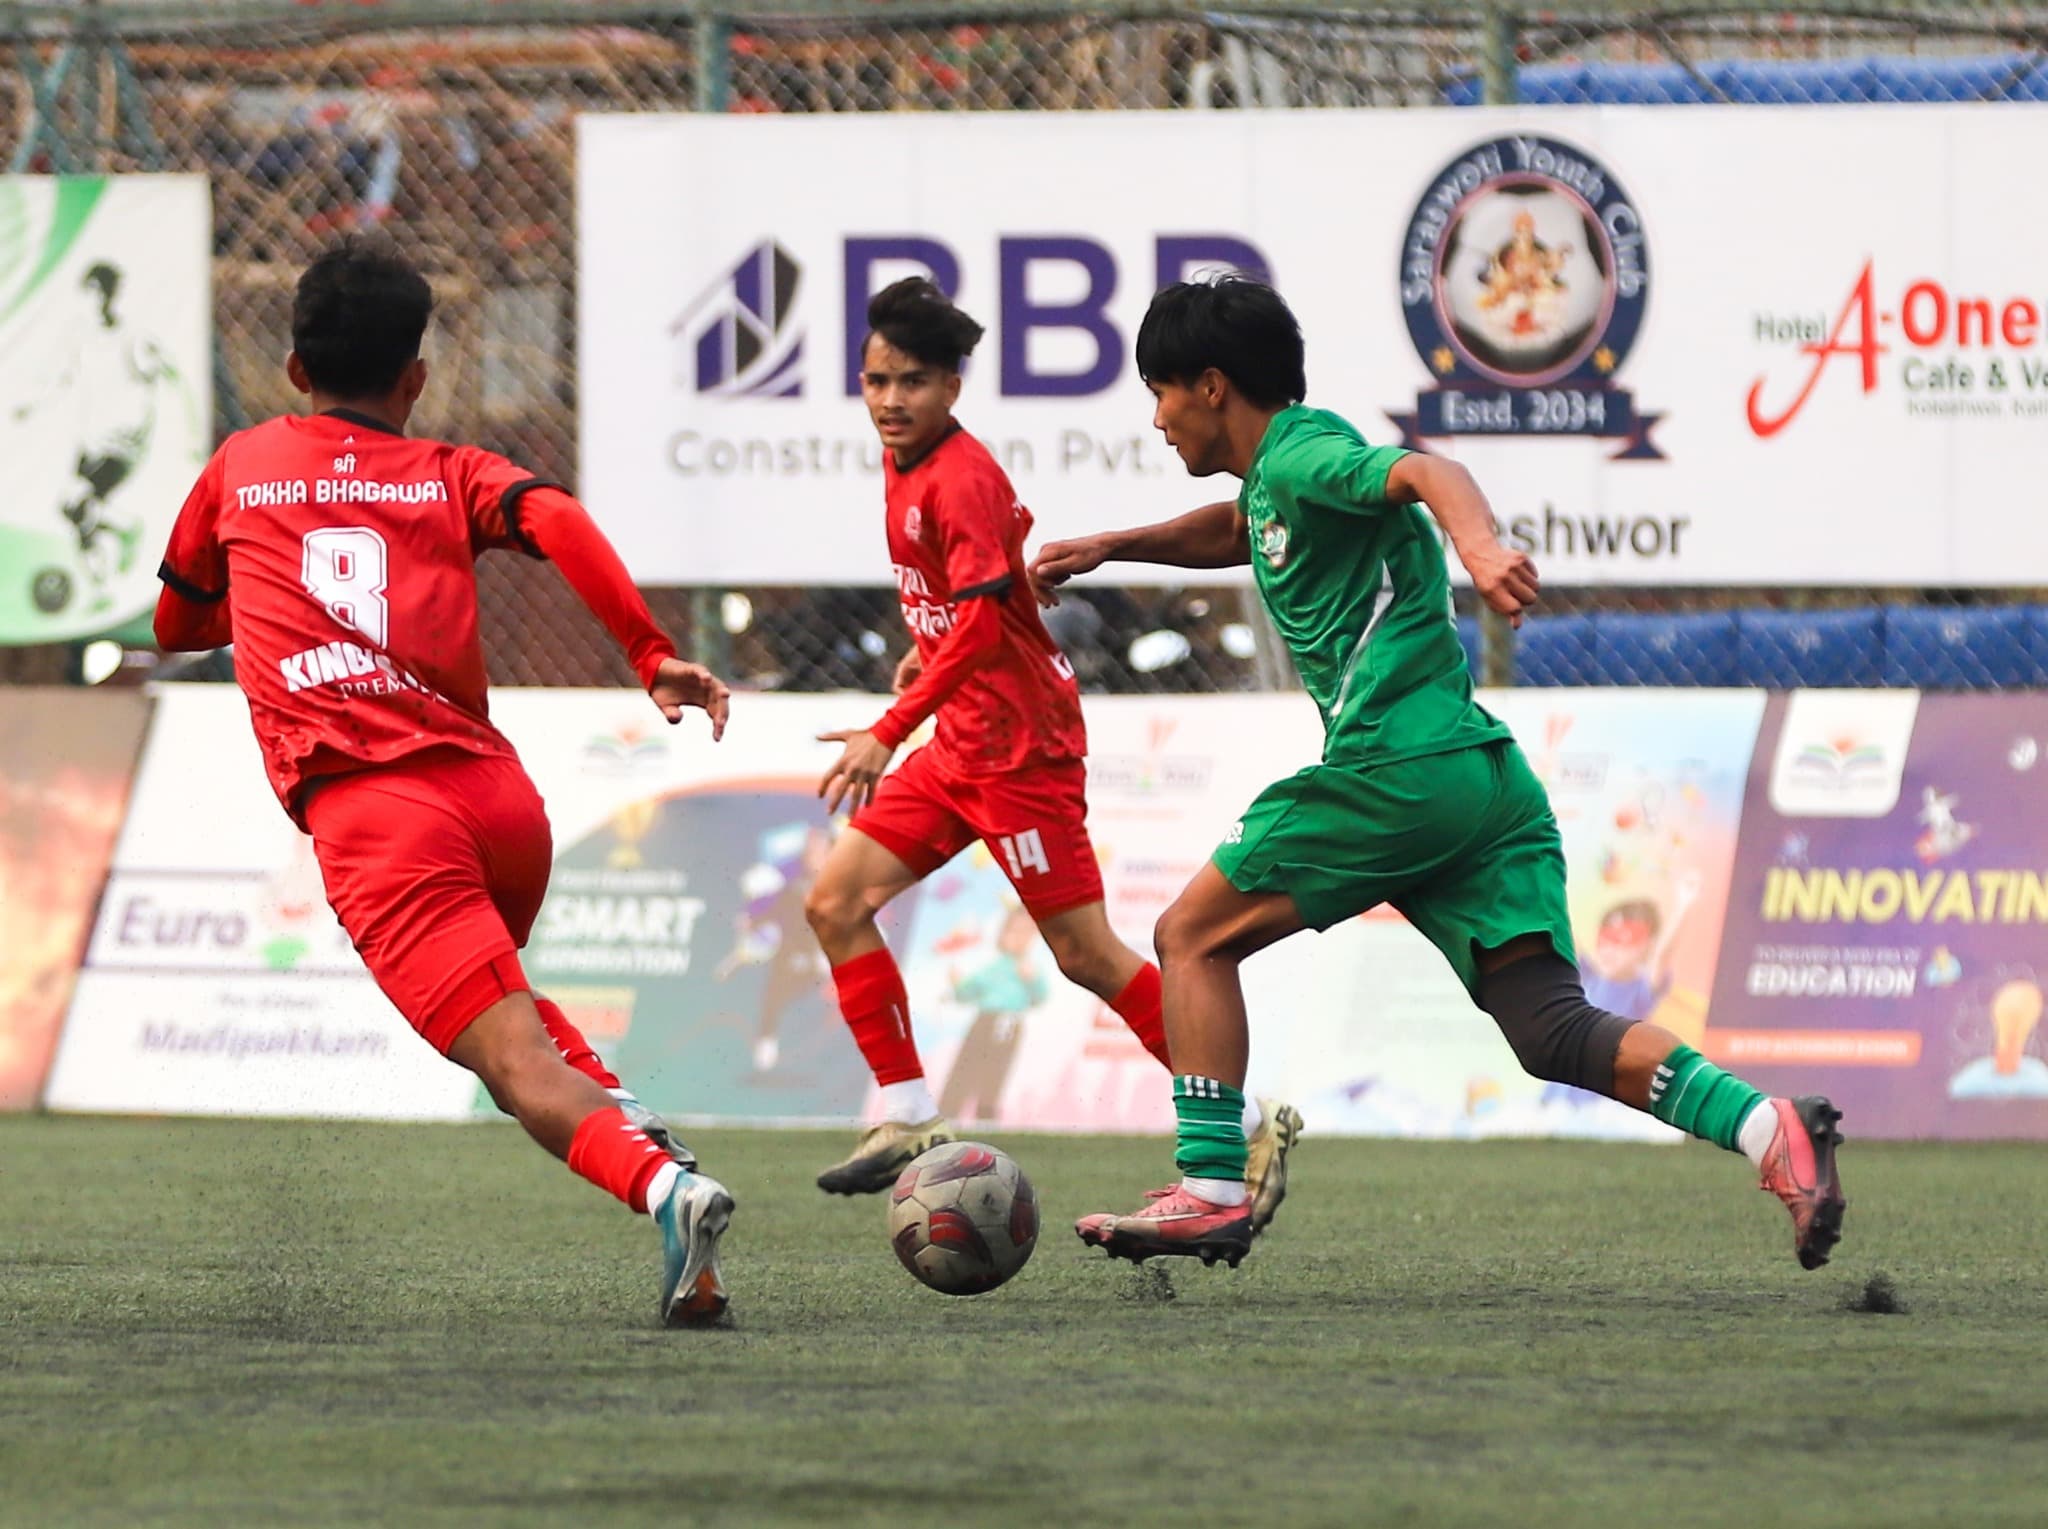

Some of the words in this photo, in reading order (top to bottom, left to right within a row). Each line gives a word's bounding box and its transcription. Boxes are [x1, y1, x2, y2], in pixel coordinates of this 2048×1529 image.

[1512, 135, 1607, 204] Youth
[1602, 203, 1651, 299] Club
[1756, 312, 1827, 345] Hotel
[1902, 357, 1975, 392] Cafe
[1984, 357, 2011, 392] &
[1441, 388, 1520, 431] Estd.
[1527, 388, 1607, 431] 2034
[1059, 428, 1165, 476] Pvt.
[236, 479, 307, 511] TOKHA
[301, 526, 388, 650] 8
[999, 827, 1051, 878] 14
[118, 898, 248, 946] Euro
[544, 897, 706, 943] SMART
[1747, 964, 1918, 997] EDUCATION
